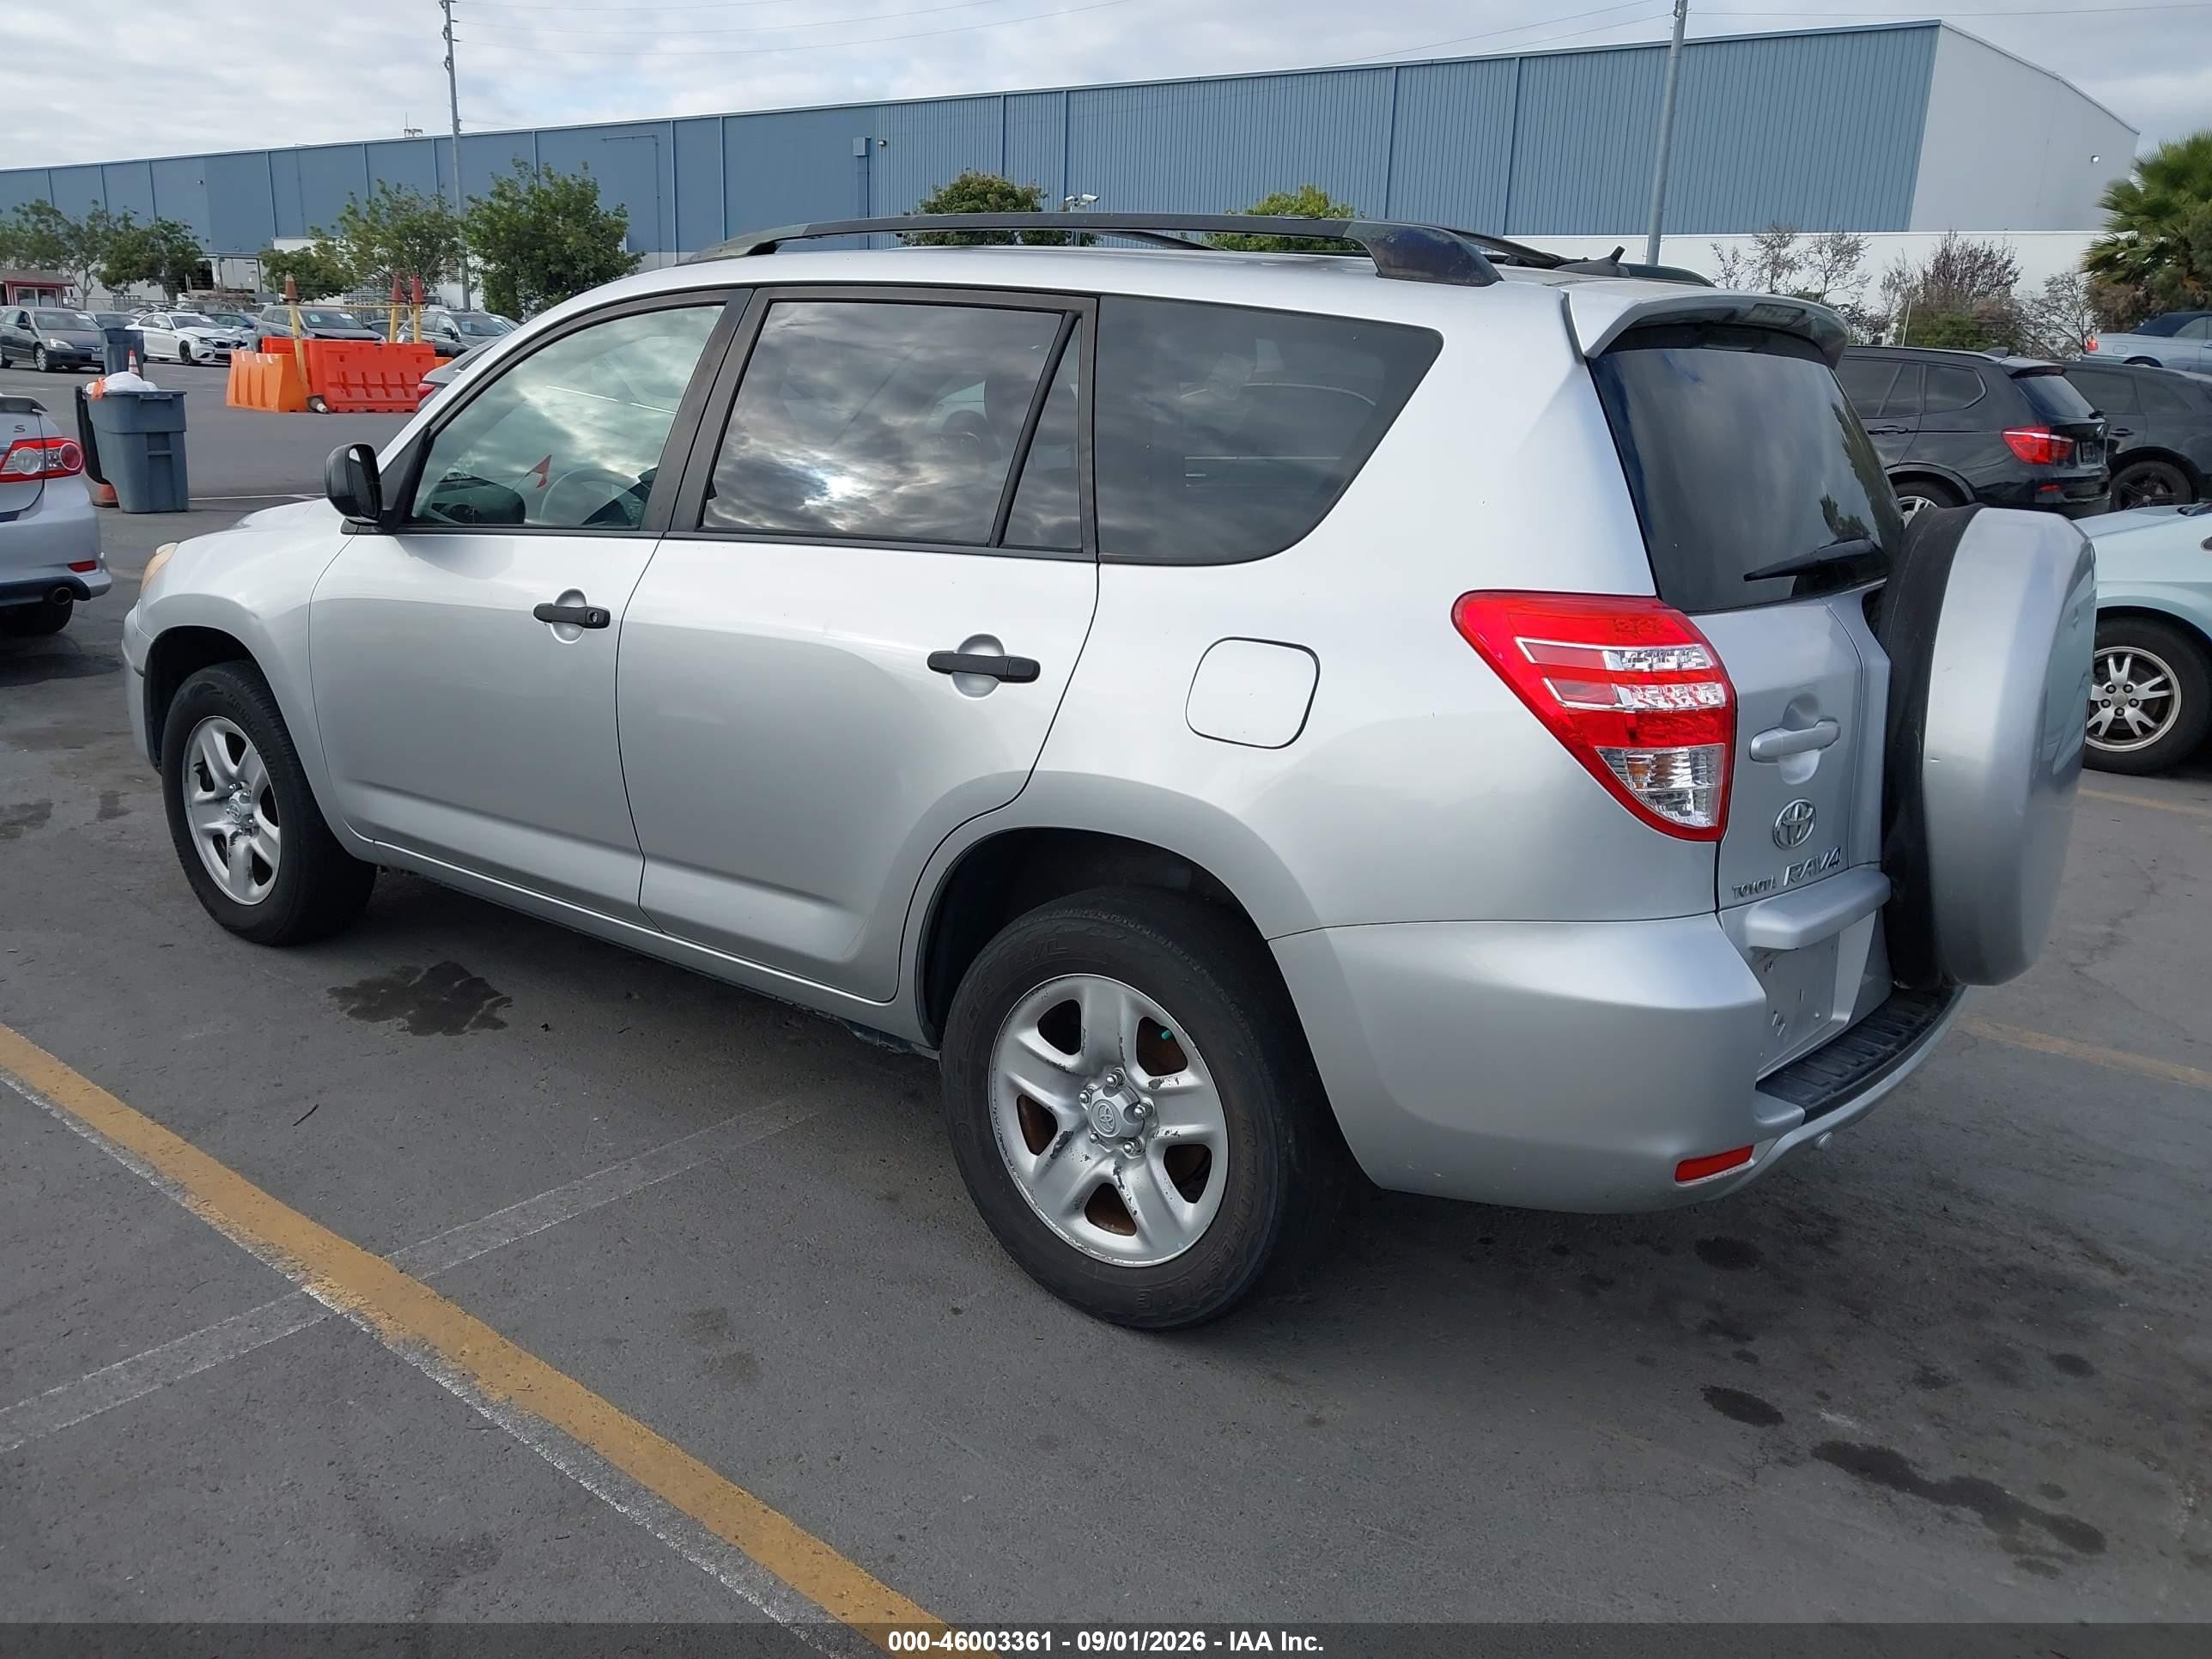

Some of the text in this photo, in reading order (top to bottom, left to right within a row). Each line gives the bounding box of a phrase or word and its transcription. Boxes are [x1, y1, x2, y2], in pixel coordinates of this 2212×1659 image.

[13, 424, 26, 434] S
[1731, 846, 1842, 899] TOYOTA RAV4
